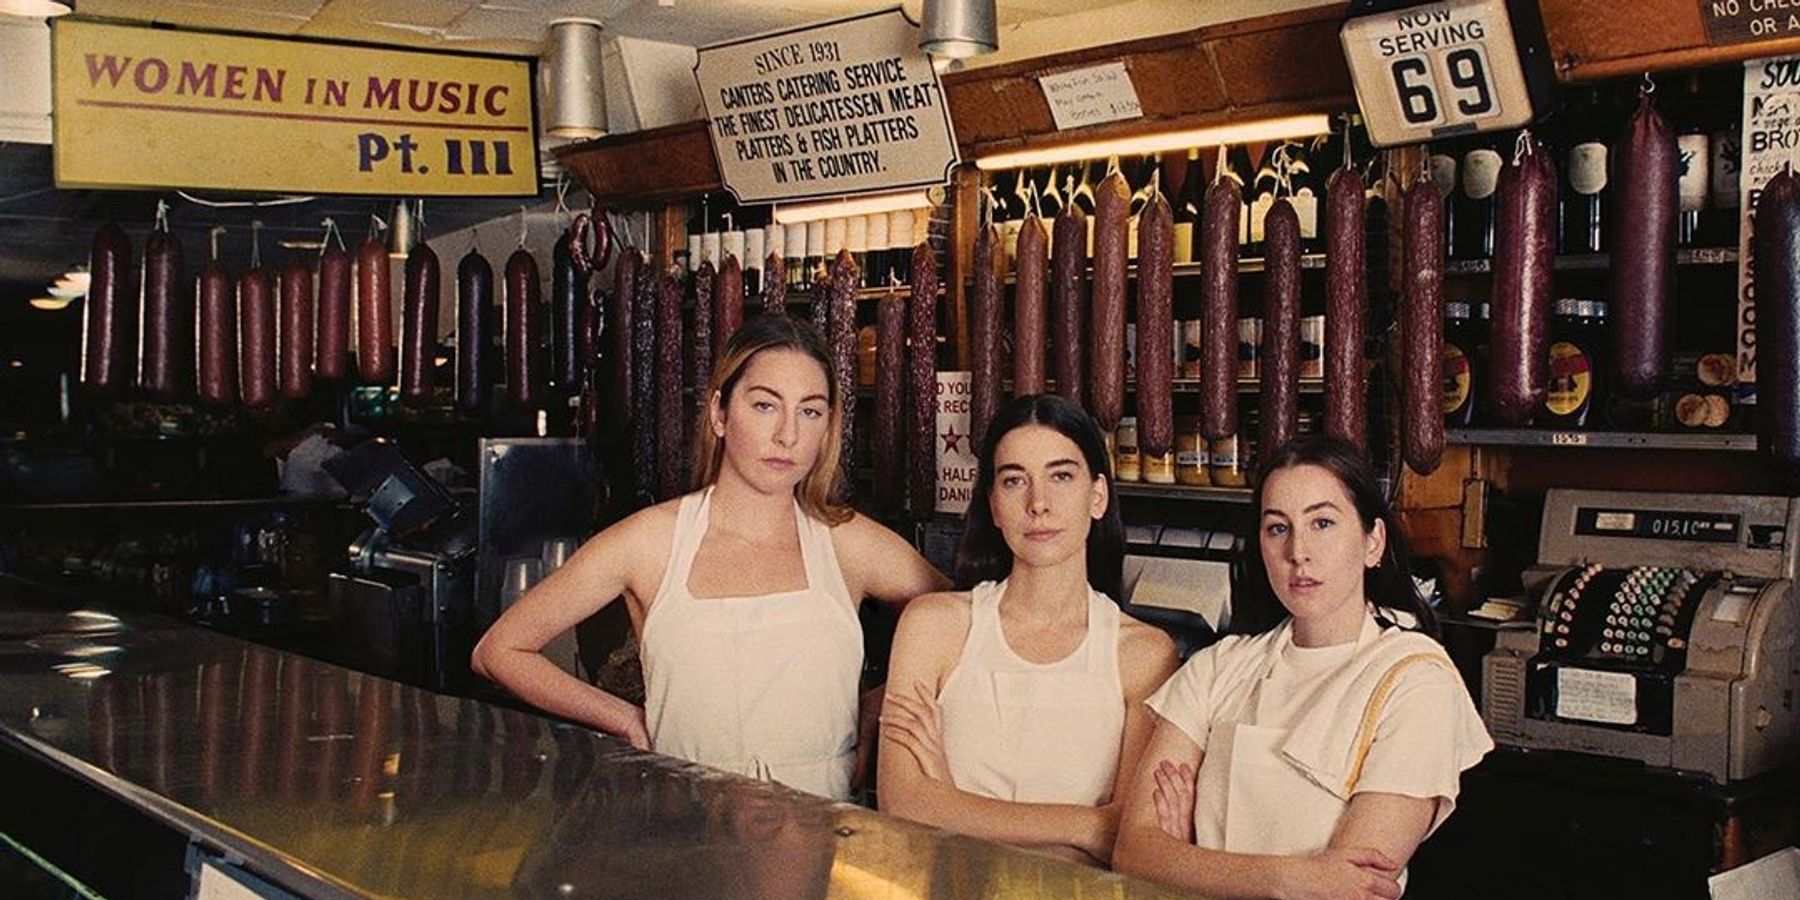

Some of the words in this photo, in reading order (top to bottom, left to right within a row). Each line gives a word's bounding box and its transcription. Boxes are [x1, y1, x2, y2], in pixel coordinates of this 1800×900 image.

[1398, 10, 1452, 31] NOW
[1713, 0, 1740, 17] NO
[1750, 17, 1778, 36] OR
[1379, 20, 1485, 57] SERVING
[754, 43, 804, 76] SINCE
[809, 41, 840, 62] 1931
[84, 53, 286, 103] WOMEN
[304, 77, 350, 107] IN
[363, 76, 510, 117] MUSIC
[720, 81, 775, 110] CANTERS
[776, 69, 841, 101] CATERING
[844, 57, 907, 90] SERVICE
[1391, 48, 1492, 124] 69
[713, 115, 738, 138] THE
[739, 108, 780, 135] FINEST
[784, 91, 884, 128] DELICATESSEN
[358, 132, 429, 174] Pt.
[445, 139, 513, 175] III
[735, 133, 793, 161] PLATTERS
[796, 133, 808, 153] &
[810, 127, 842, 152] FISH
[845, 115, 919, 148] PLATTERS
[772, 161, 787, 183] IN
[789, 158, 816, 182] THE
[818, 149, 887, 179] COUNTRY.
[943, 468, 977, 482] HALF
